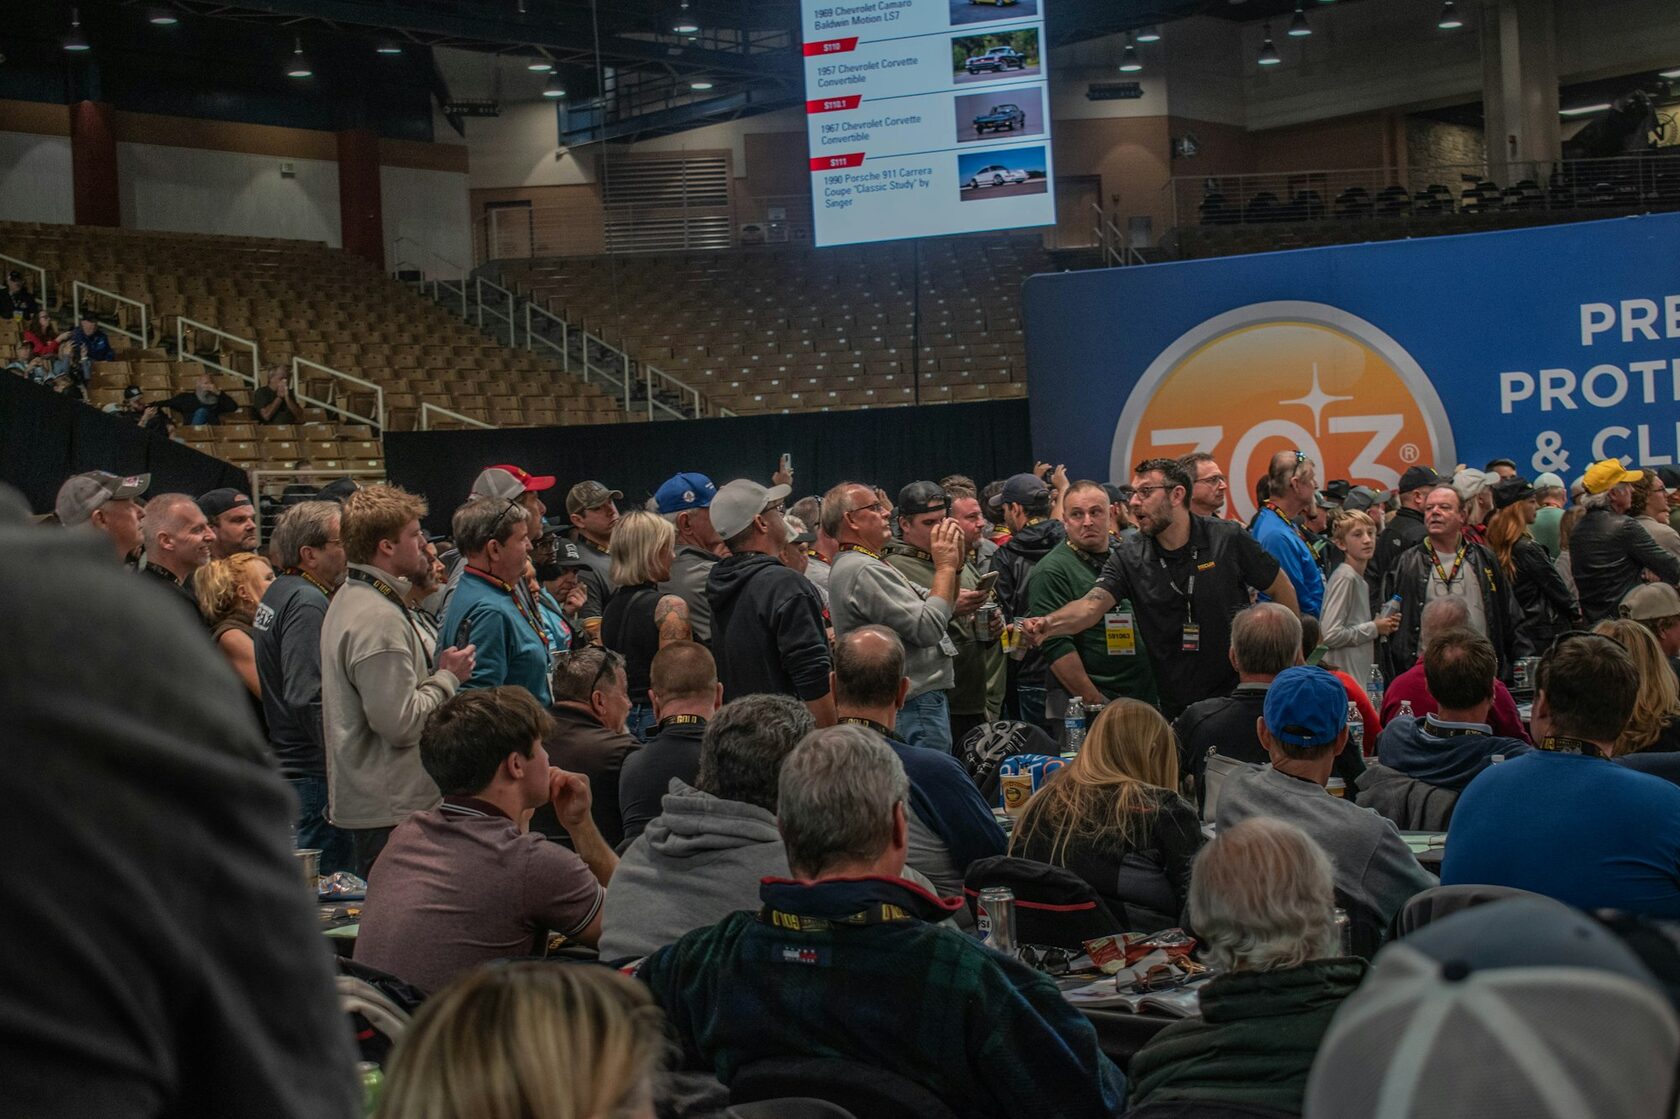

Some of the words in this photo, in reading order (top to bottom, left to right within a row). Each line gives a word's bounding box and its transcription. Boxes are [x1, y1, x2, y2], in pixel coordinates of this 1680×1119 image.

[814, 8, 834, 19] 1969
[835, 3, 877, 16] Chevrolet
[878, 0, 913, 11] Camaro
[814, 19, 850, 31] Baldwin
[851, 14, 882, 26] Motion
[884, 10, 900, 22] LS7
[838, 61, 880, 74] Chevrolet
[881, 57, 920, 69] Corvette
[818, 74, 867, 88] Convertible
[841, 120, 883, 132] Chevrolet
[884, 115, 922, 127] Corvette
[821, 132, 870, 146] Convertible
[830, 158, 847, 167] S111
[844, 171, 881, 183] Porsche
[882, 169, 897, 179] 911
[899, 167, 932, 178] Carrera
[824, 186, 853, 198] Coupe
[918, 178, 930, 189] by
[825, 198, 854, 210] Singer
[1500, 358, 1680, 414] PROT
[1531, 430, 1571, 474] &
[1592, 422, 1680, 468] CL
